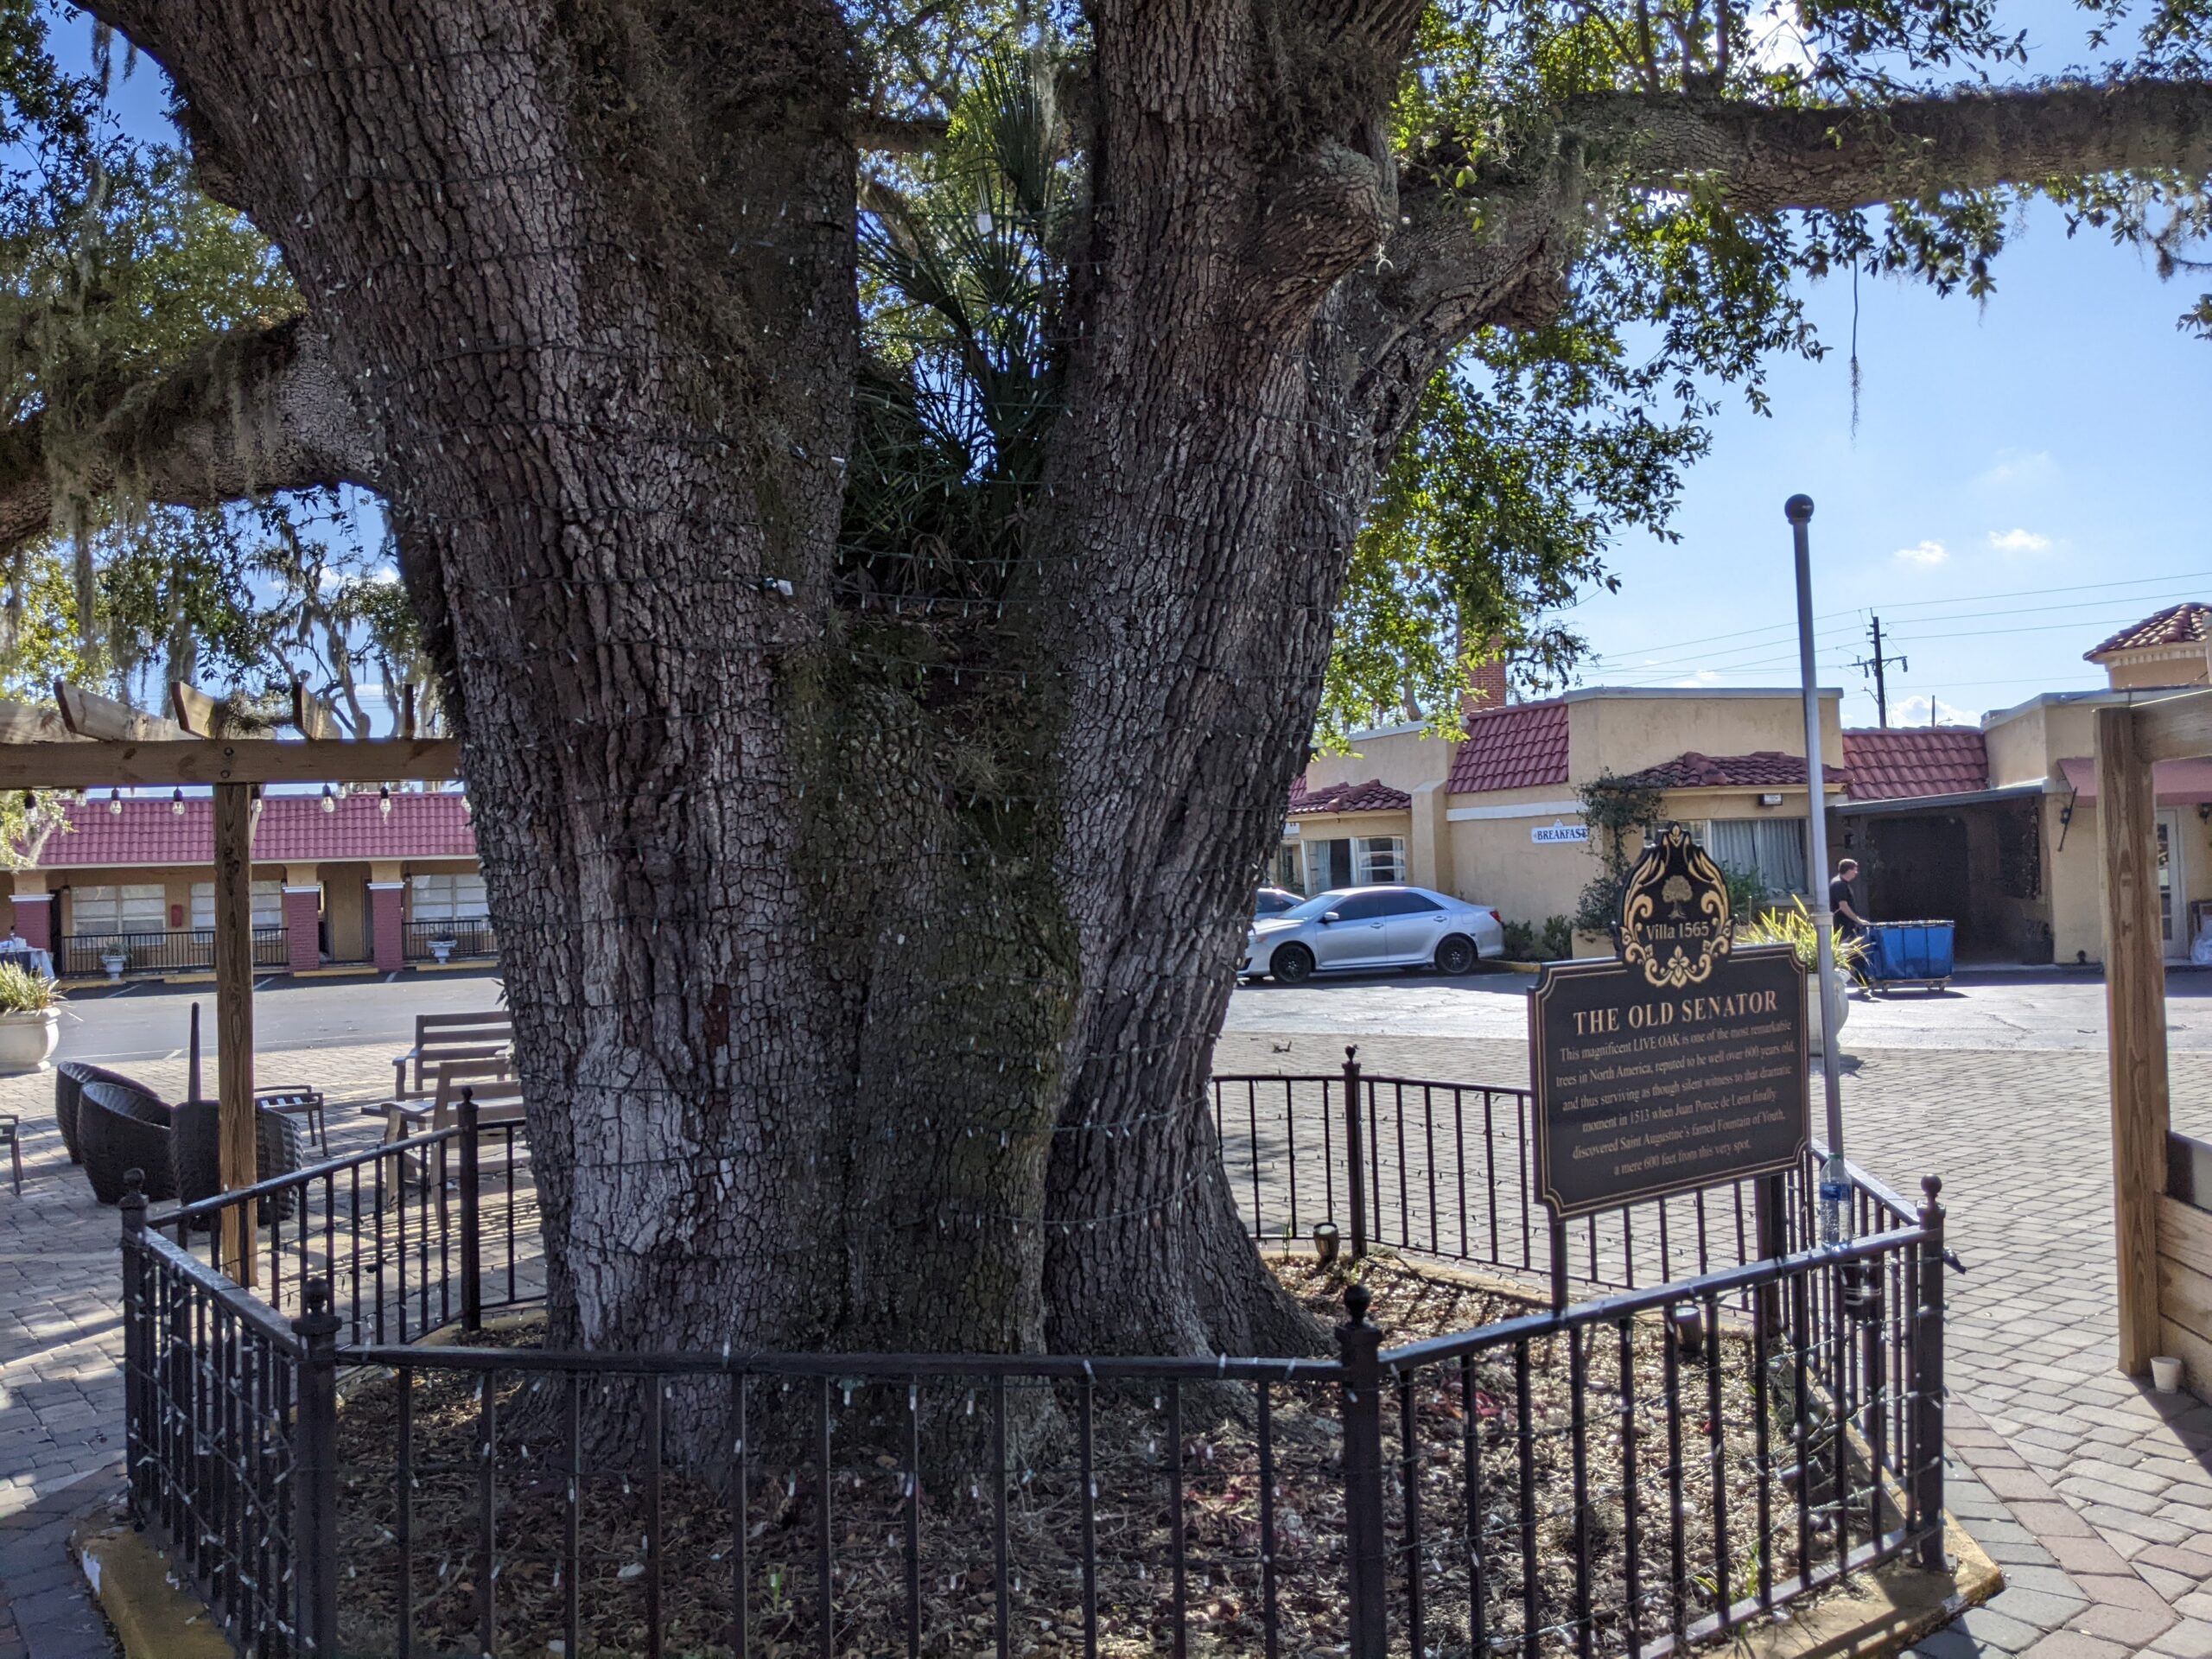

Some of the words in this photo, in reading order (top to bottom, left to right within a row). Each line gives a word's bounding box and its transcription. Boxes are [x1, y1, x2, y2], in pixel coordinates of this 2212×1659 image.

[1537, 828, 1587, 840] BREAKFAST
[1646, 924, 1675, 940] Villa
[1679, 921, 1709, 938] 1565
[1573, 1008, 1619, 1035] THE
[1628, 1002, 1674, 1028] OLD
[1681, 990, 1777, 1022] SENATOR
[1560, 1047, 1580, 1062] This
[1582, 1041, 1631, 1060] magnificent
[1633, 1037, 1656, 1052] LIVE
[1658, 1033, 1680, 1047] OAK
[1691, 1034, 1705, 1043] one
[1707, 1028, 1715, 1040] of
[1717, 1027, 1728, 1039] the
[1556, 1076, 1577, 1087] trees
[1580, 1071, 1587, 1084] in
[1590, 1068, 1614, 1081] North
[1656, 1055, 1685, 1074] reputed
[1687, 1056, 1694, 1066] to
[1696, 1053, 1706, 1065] be
[1708, 1050, 1725, 1063] well
[1726, 1051, 1743, 1060] over
[1745, 1045, 1758, 1058] 600
[1760, 1046, 1780, 1059] years
[1562, 1096, 1579, 1111] and
[1581, 1094, 1599, 1108] thus
[1600, 1088, 1640, 1103] surviving
[1641, 1088, 1650, 1098] as
[1652, 1079, 1680, 1096] though
[1681, 1077, 1702, 1091] silent
[1734, 1073, 1743, 1083] to
[1745, 1069, 1758, 1081] that
[1583, 1117, 1617, 1133] moment
[1619, 1114, 1627, 1126] in
[1630, 1109, 1649, 1123] 1513
[1651, 1106, 1674, 1120] when
[1675, 1103, 1694, 1116] Juan
[1695, 1099, 1719, 1112] Ponce
[1720, 1094, 1730, 1108] de
[1753, 1087, 1777, 1102] finally
[1573, 1138, 1618, 1160] discovered
[1620, 1136, 1642, 1150] Saint
[1718, 1116, 1751, 1131] Fountain
[1752, 1113, 1761, 1125] of
[1614, 1166, 1619, 1176] a
[1621, 1160, 1642, 1174] mere
[1643, 1154, 1660, 1168] 600
[1662, 1152, 1676, 1166] feet
[1678, 1150, 1697, 1162] from
[1699, 1145, 1713, 1159] this
[1714, 1143, 1731, 1155] very
